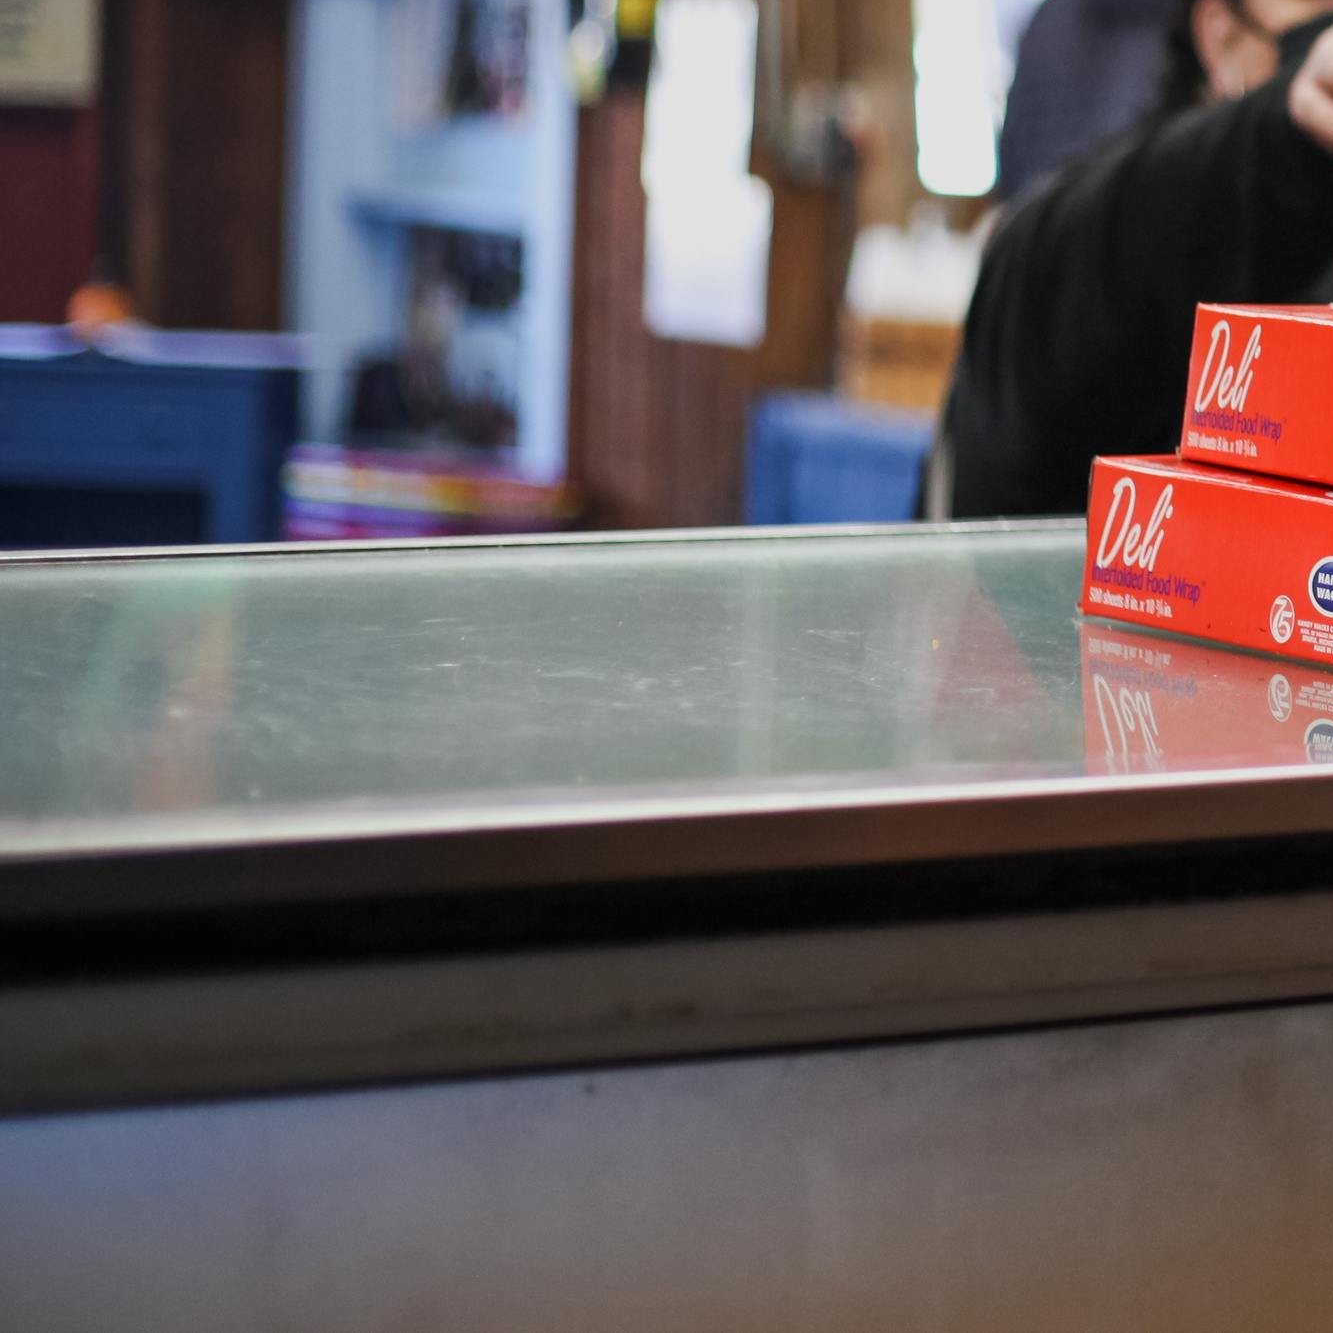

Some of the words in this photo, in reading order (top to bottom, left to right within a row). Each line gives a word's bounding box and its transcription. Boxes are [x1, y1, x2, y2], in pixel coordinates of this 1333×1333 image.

[1195, 320, 1261, 412] Deli
[1097, 477, 1173, 572] Deli
[1147, 571, 1171, 596] Food
